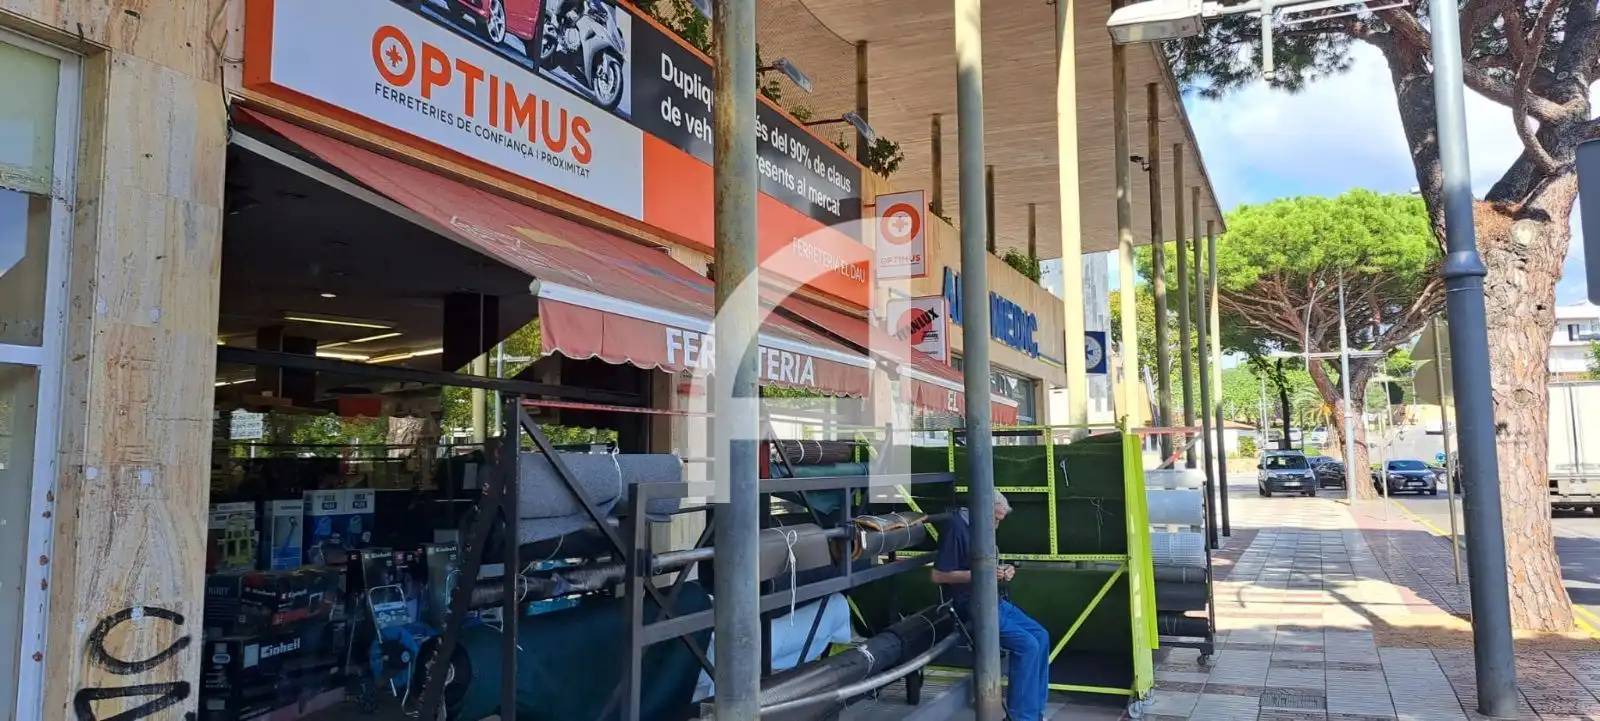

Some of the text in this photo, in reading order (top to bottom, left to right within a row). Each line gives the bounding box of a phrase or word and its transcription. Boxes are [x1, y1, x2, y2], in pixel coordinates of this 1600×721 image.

[372, 25, 592, 164] OPTIMUS
[375, 82, 454, 125] FERRETERIES
[456, 117, 471, 133] DE
[475, 123, 535, 160] CONFIANÇA
[541, 153, 591, 179] PROXIMITAT
[661, 52, 852, 193] Dupliq és del 90% de claus
[661, 97, 682, 127] de
[797, 178, 806, 197] al
[809, 185, 841, 217] mercat
[792, 237, 866, 283] FERRETERIA EL DAU
[881, 255, 921, 264] OPTIMUS
[666, 327, 815, 387] FERTERIA
[260, 637, 301, 659] Einhell
